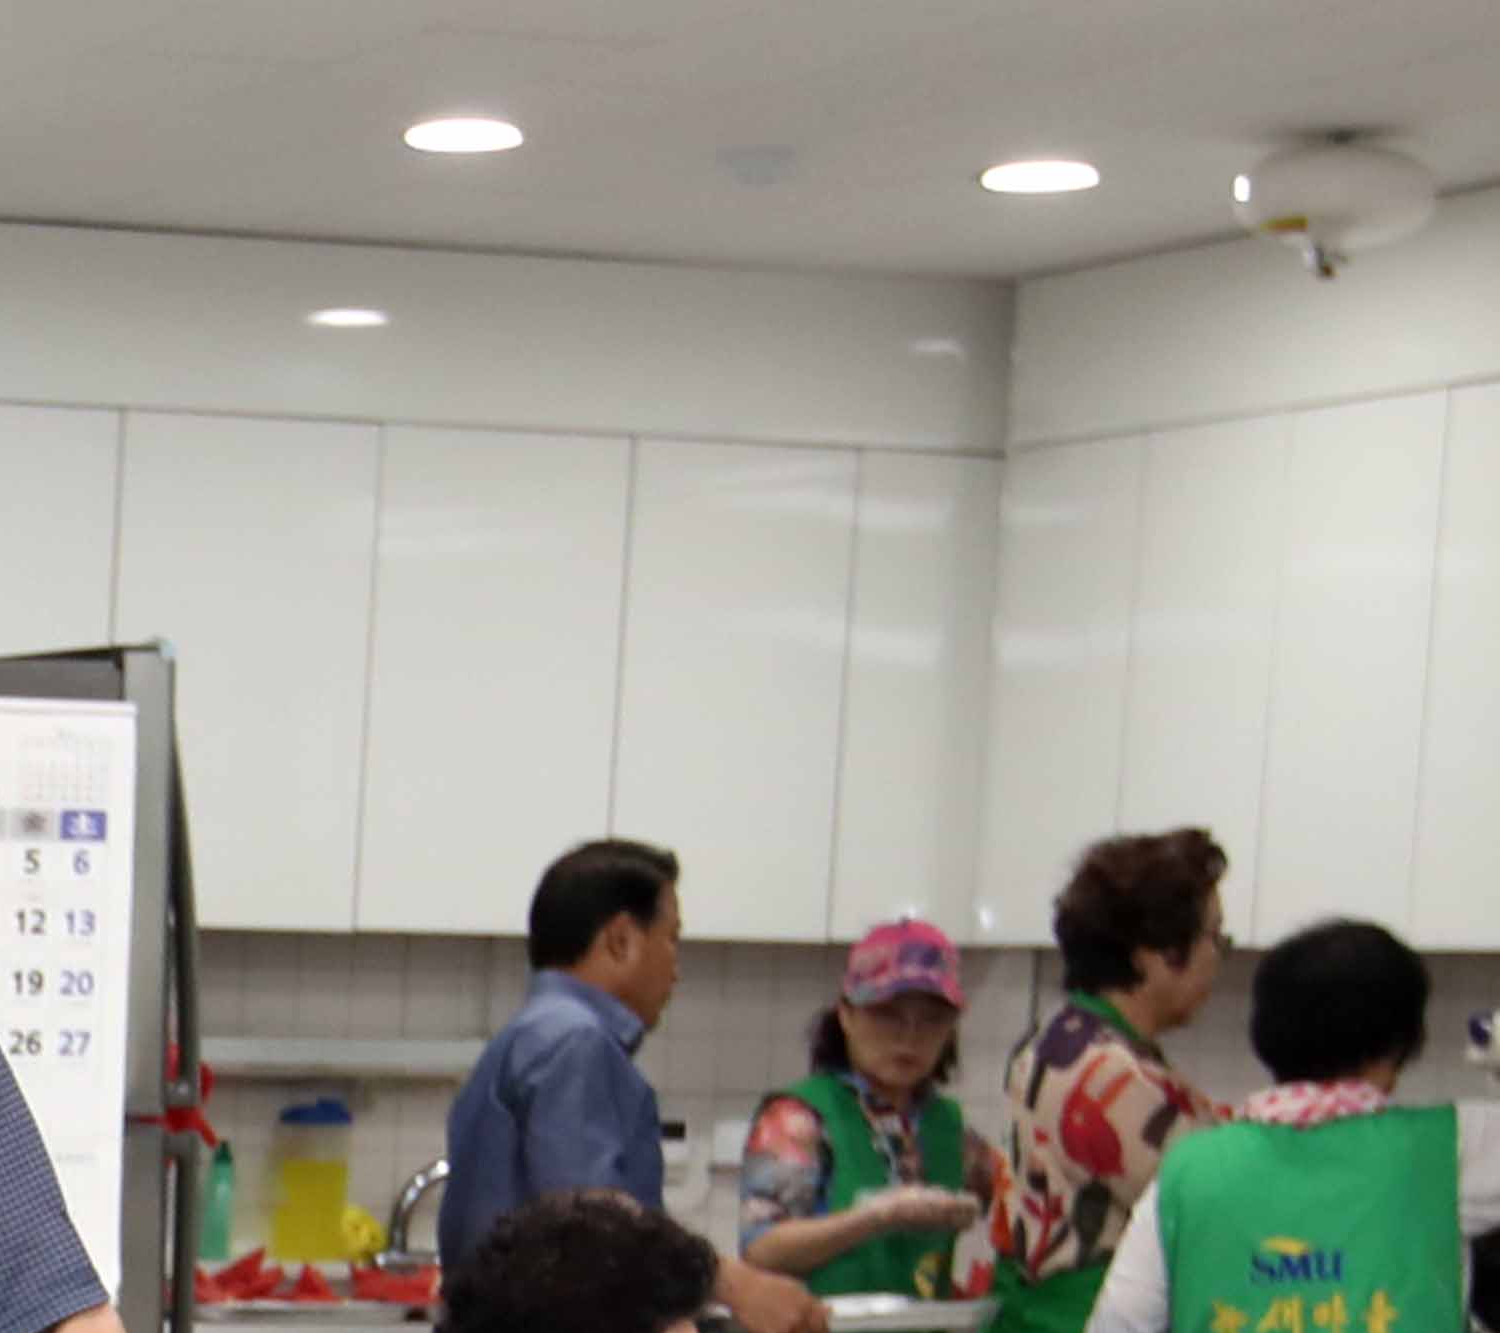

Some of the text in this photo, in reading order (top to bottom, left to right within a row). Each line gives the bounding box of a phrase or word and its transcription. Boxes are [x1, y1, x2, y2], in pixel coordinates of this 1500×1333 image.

[23, 849, 41, 874] 5
[73, 850, 90, 875] 6
[16, 909, 46, 935] 12
[64, 911, 96, 936] 13
[13, 970, 44, 996] 19
[60, 971, 94, 996] 20
[9, 1032, 90, 1057] 26 27
